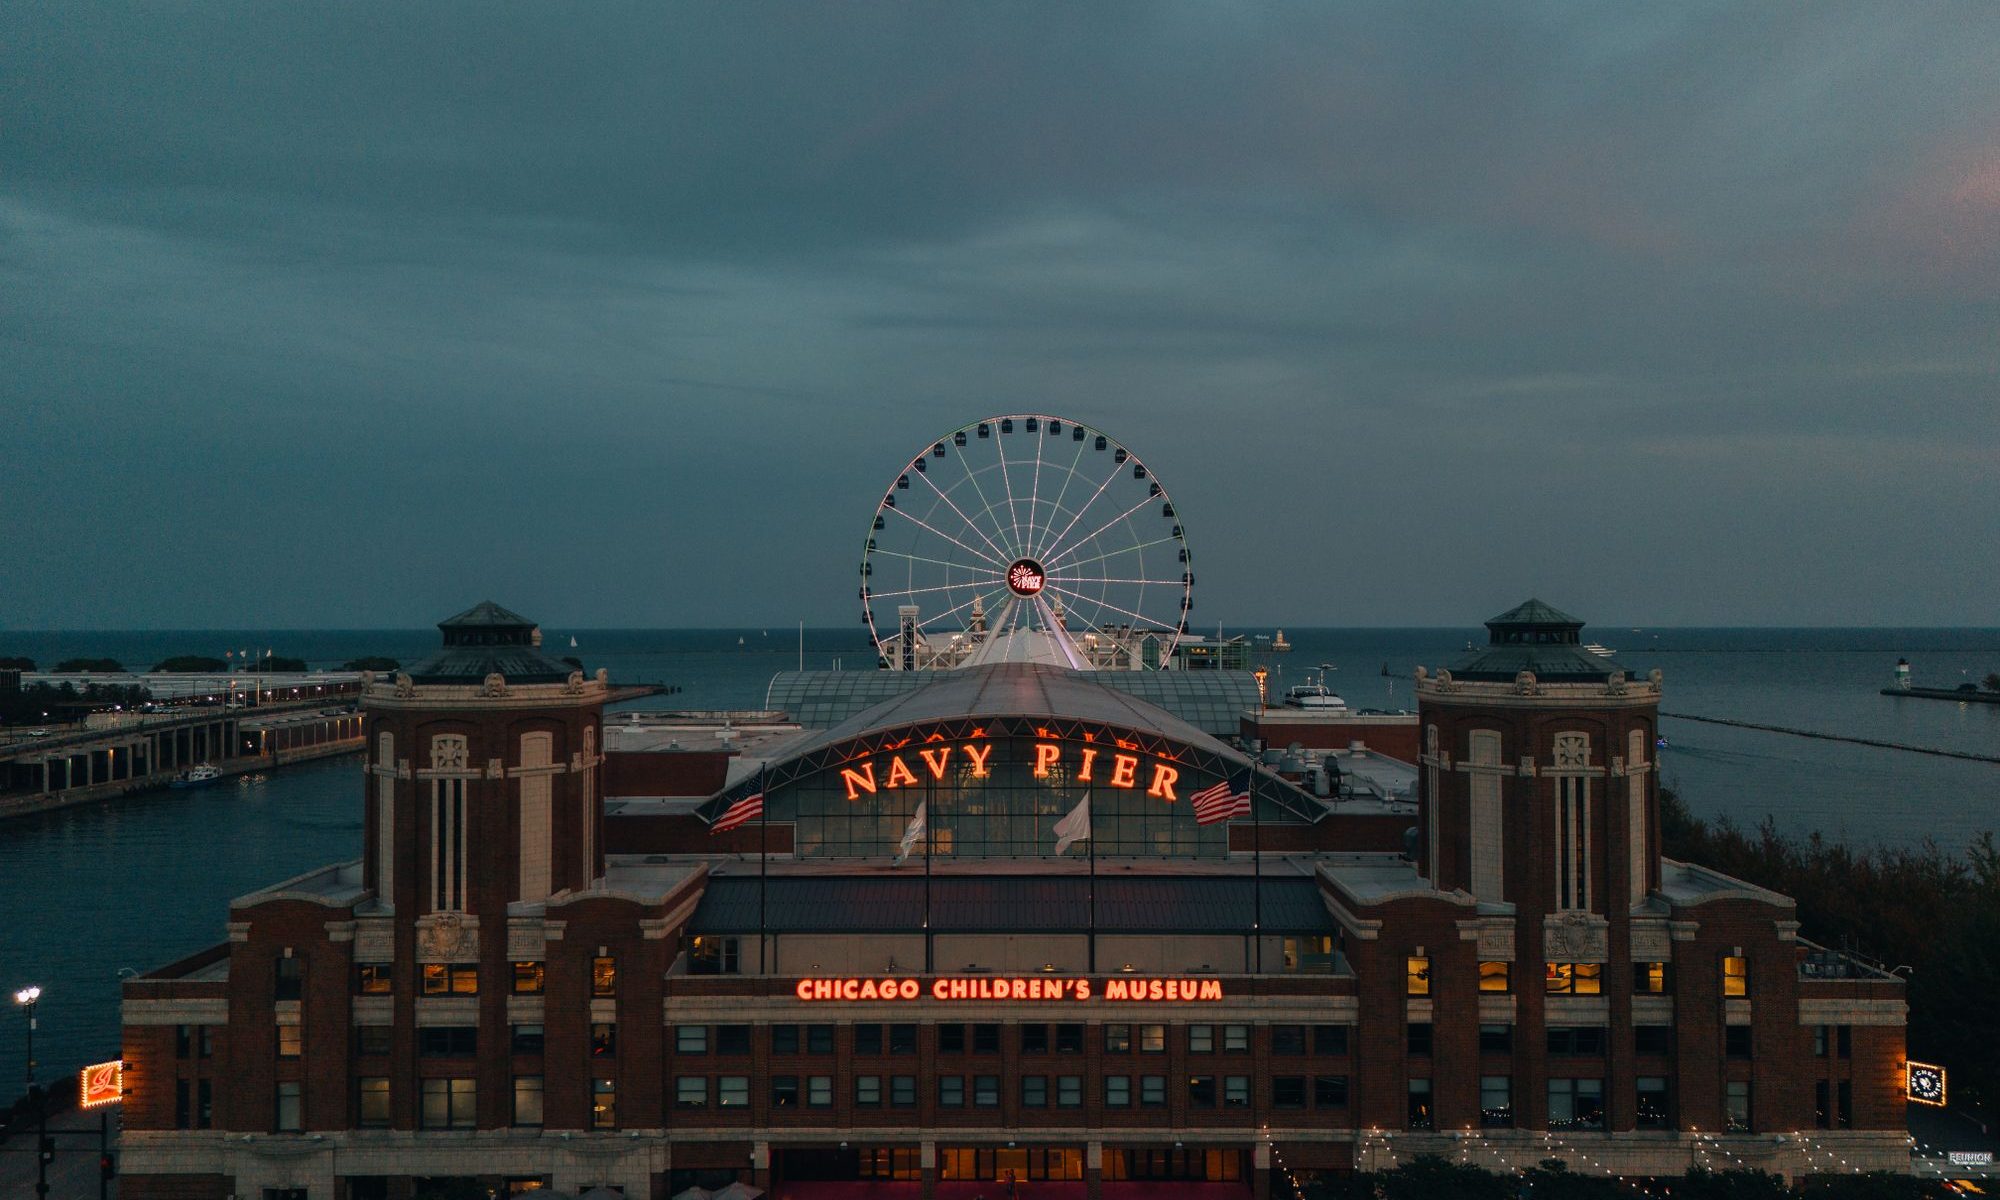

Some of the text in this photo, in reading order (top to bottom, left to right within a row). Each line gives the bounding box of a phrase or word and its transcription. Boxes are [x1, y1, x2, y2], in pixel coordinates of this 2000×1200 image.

[840, 744, 1180, 801] NAVY PIER
[797, 979, 1223, 1000] CHICAGO CHILDREN'S MUSEUM
[1949, 1152, 1992, 1162] REUNION
